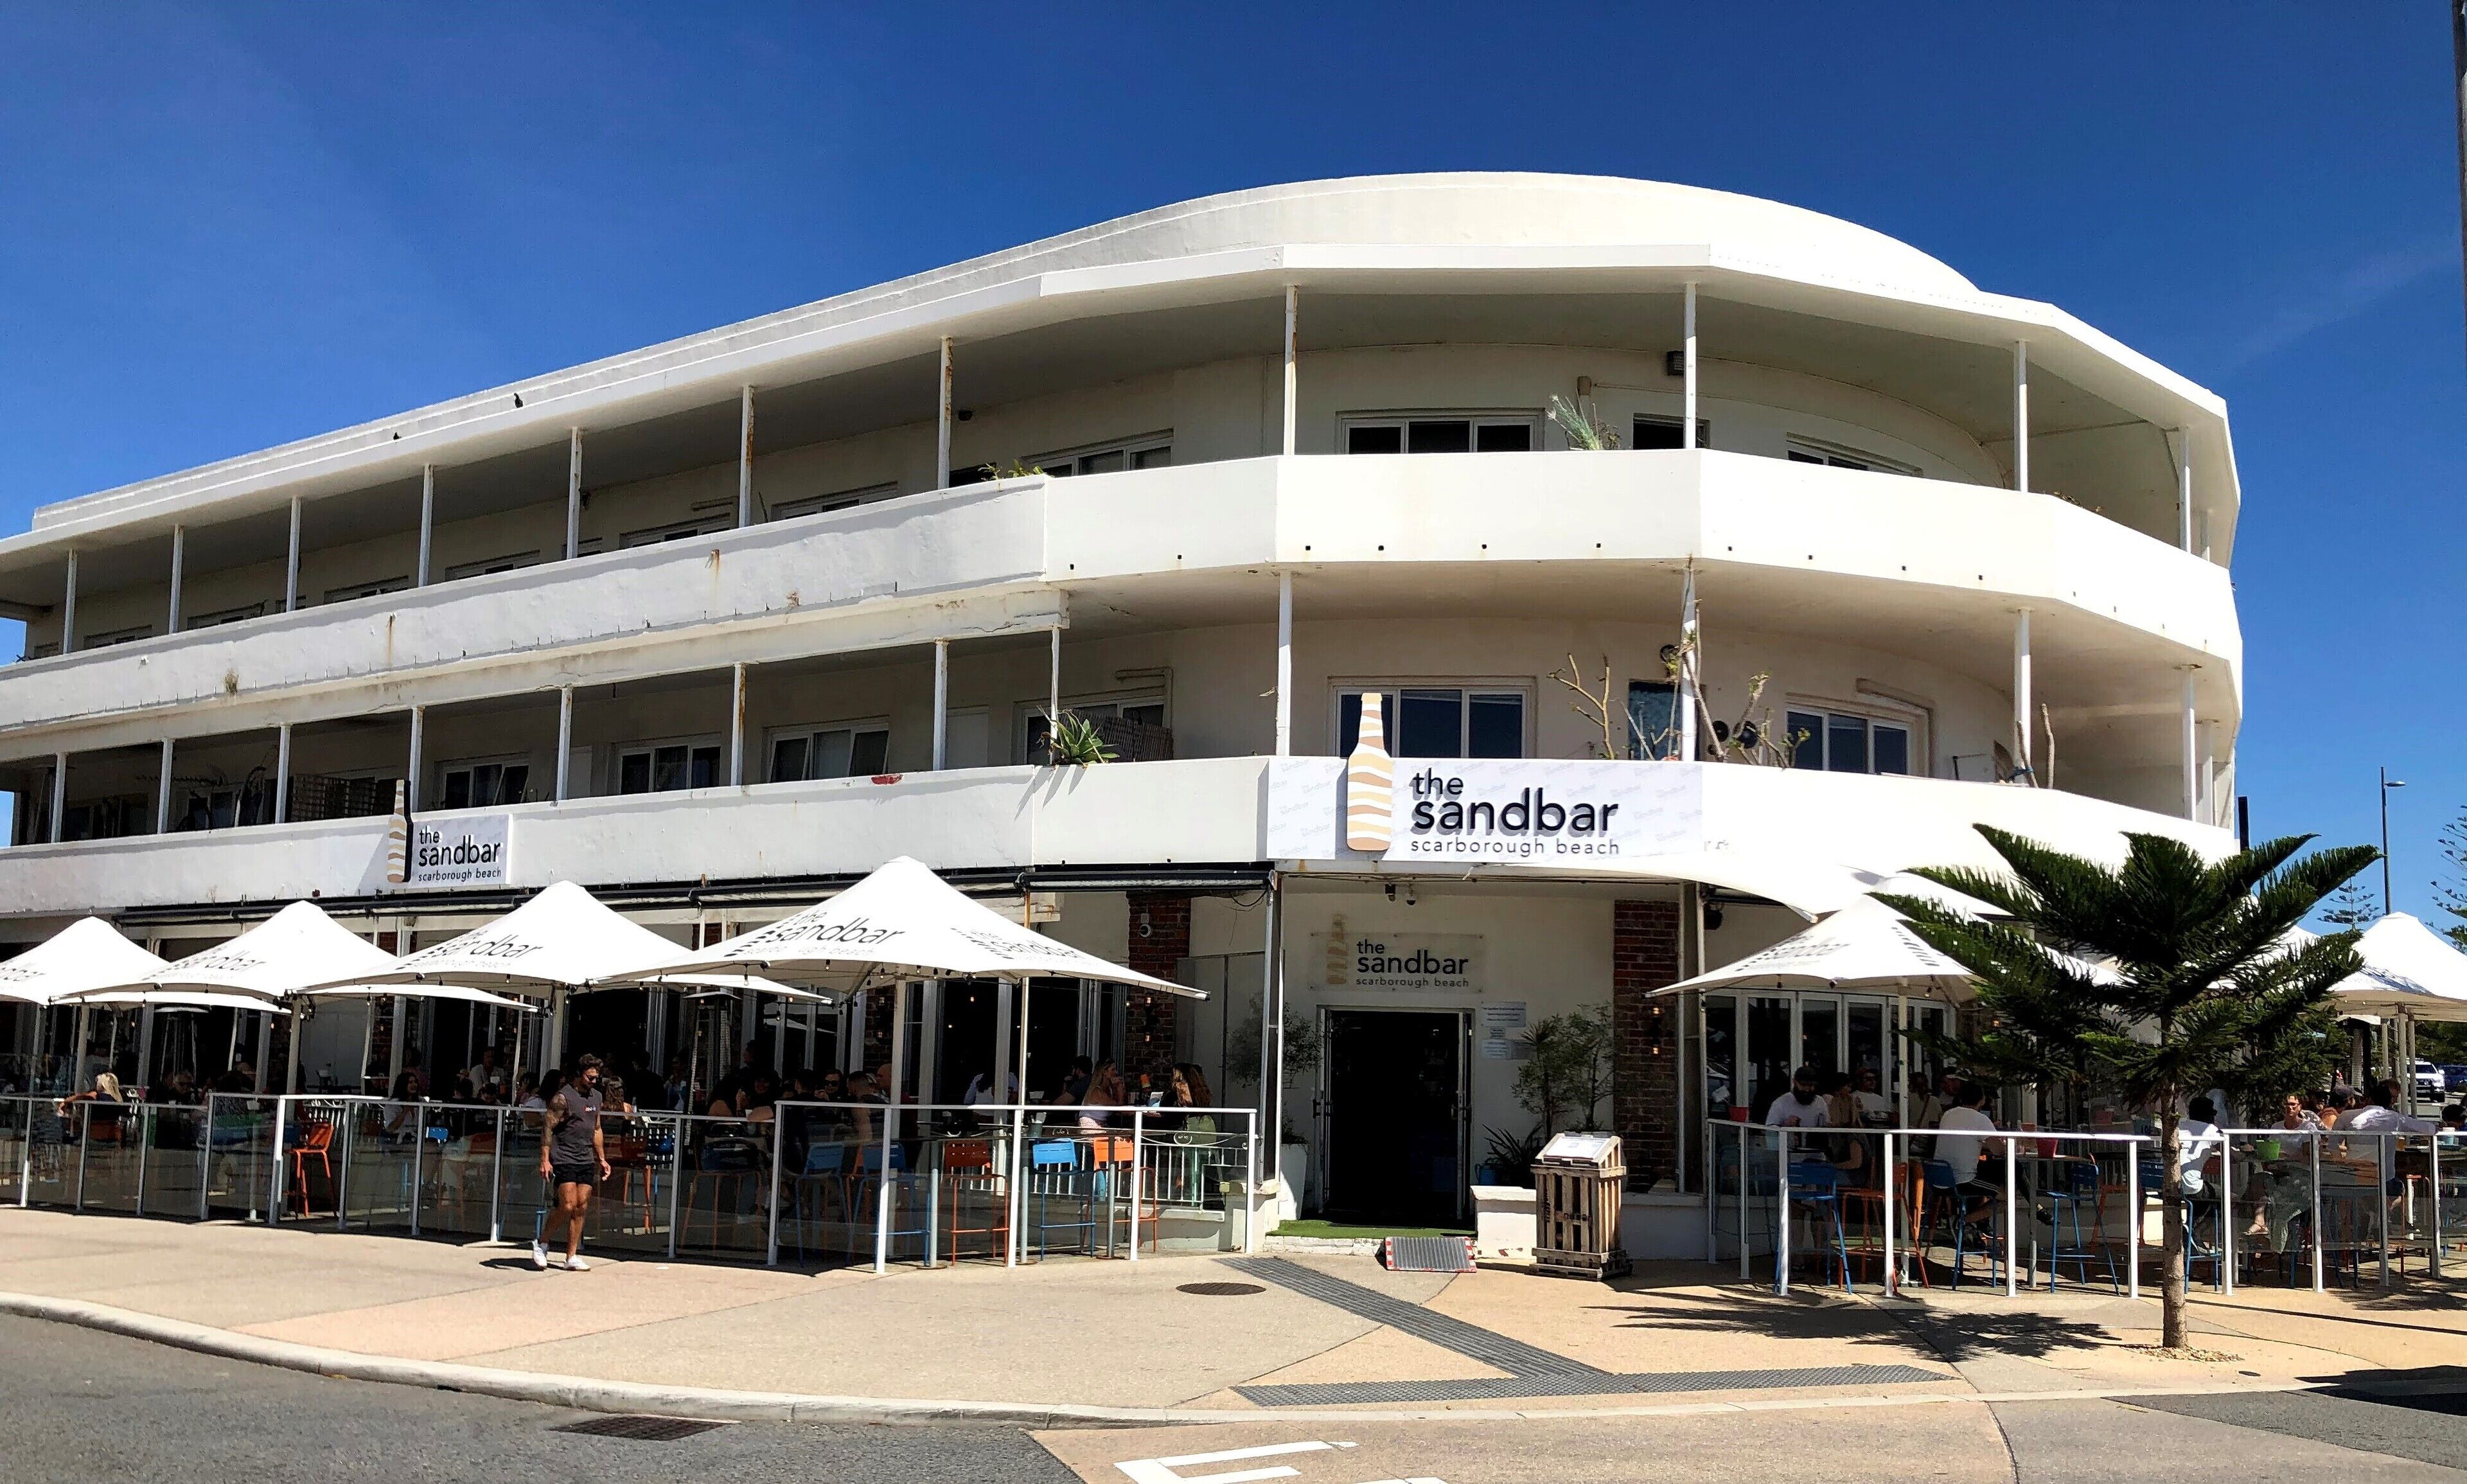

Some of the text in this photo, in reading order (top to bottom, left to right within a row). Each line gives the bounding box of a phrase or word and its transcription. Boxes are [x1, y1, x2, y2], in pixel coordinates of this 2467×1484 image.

[1413, 768, 1463, 795] the
[1413, 788, 1619, 831] sandbar
[419, 825, 440, 845] the
[1411, 836, 1620, 858] scarborough beach
[418, 835, 501, 867] sandbar
[418, 867, 502, 883] scarborough beach
[765, 917, 906, 944] sandbar
[1356, 939, 1385, 954] the
[1357, 949, 1469, 975] sandbar
[1356, 976, 1469, 988] scarborough beach
